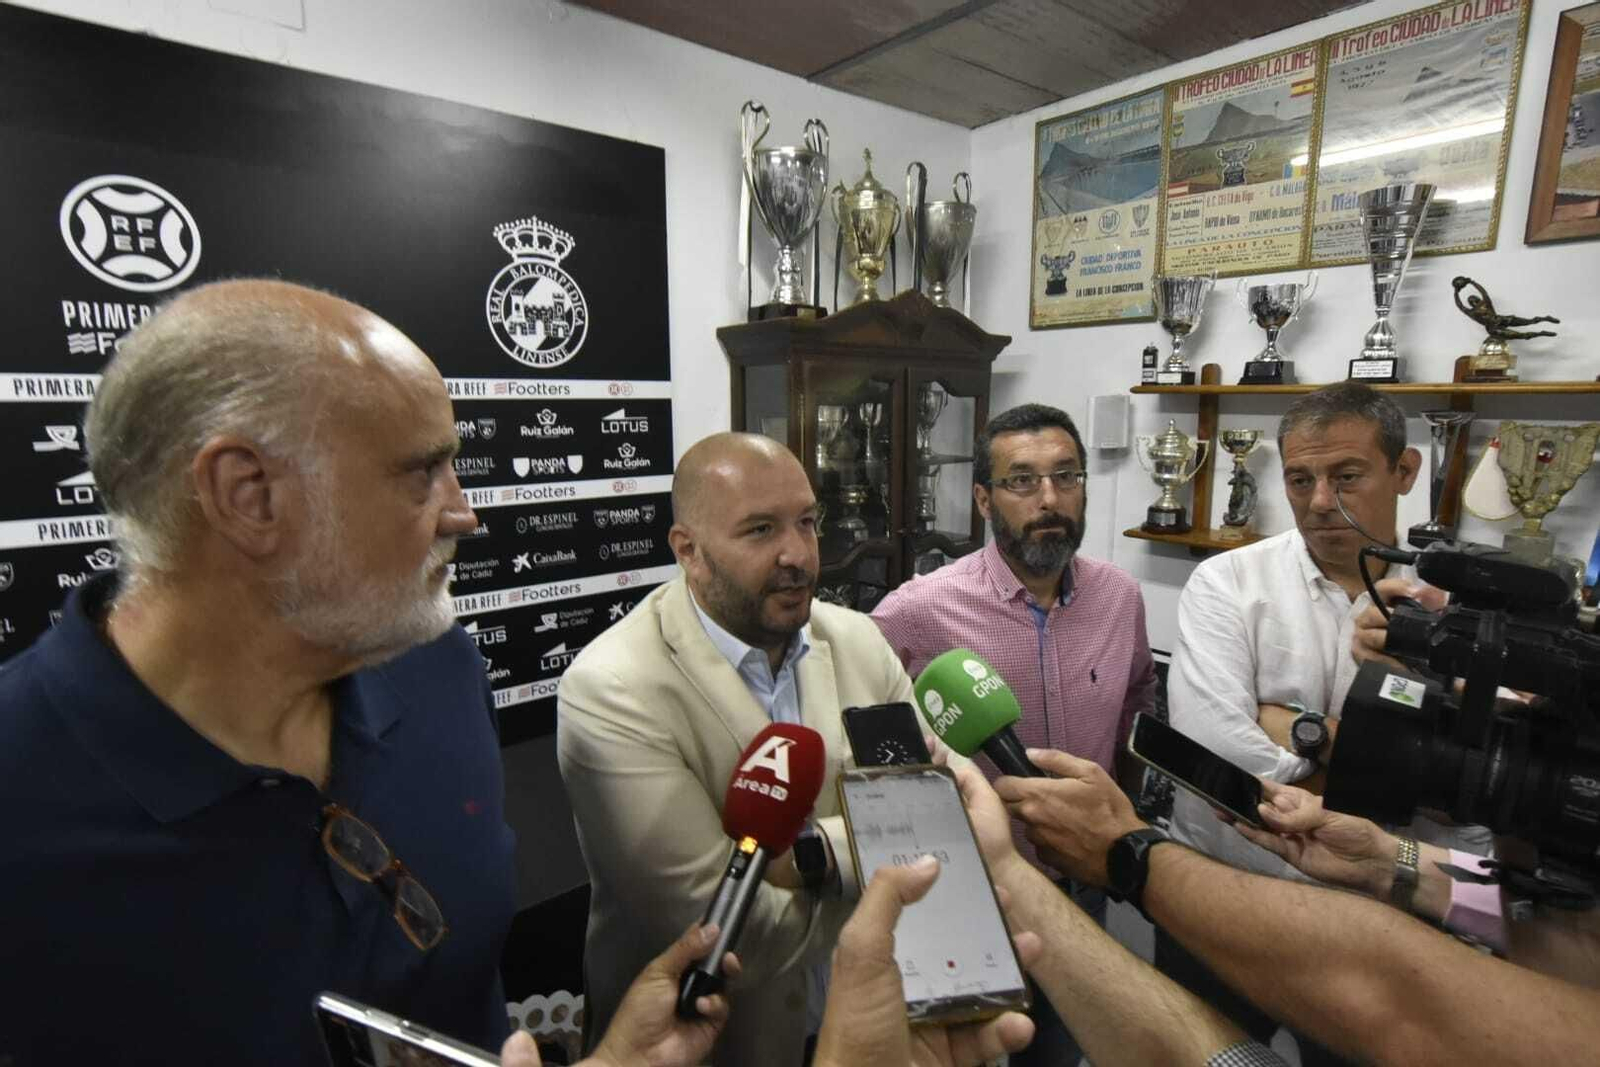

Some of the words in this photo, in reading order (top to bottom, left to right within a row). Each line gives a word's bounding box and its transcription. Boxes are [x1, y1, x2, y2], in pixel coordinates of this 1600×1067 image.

[1390, 12, 1441, 43] CIUDAD
[1451, 2, 1472, 27] LA
[1182, 76, 1220, 103] TROFEO
[1221, 62, 1260, 89] CIUDAD
[1267, 57, 1282, 78] LA
[1285, 45, 1318, 73] LINEA
[490, 288, 506, 325] REAL
[513, 345, 570, 365] LINENSE
[508, 381, 571, 397] Footters
[520, 425, 542, 437] Ruiz
[543, 424, 575, 437] Galán
[601, 420, 649, 434] LOTUS
[531, 457, 566, 468] PANDA
[603, 459, 623, 469] Ruiz
[624, 457, 651, 468] Galán
[515, 484, 576, 500] Footters
[609, 507, 640, 519] PANDA
[37, 520, 113, 542] PRIMER
[532, 549, 577, 564] CaixaBank
[57, 572, 94, 588] Rui
[521, 582, 582, 601] Footters
[471, 629, 507, 647] TUS
[486, 668, 511, 680] alán
[972, 675, 1005, 699] GPON
[933, 702, 963, 737] GPON
